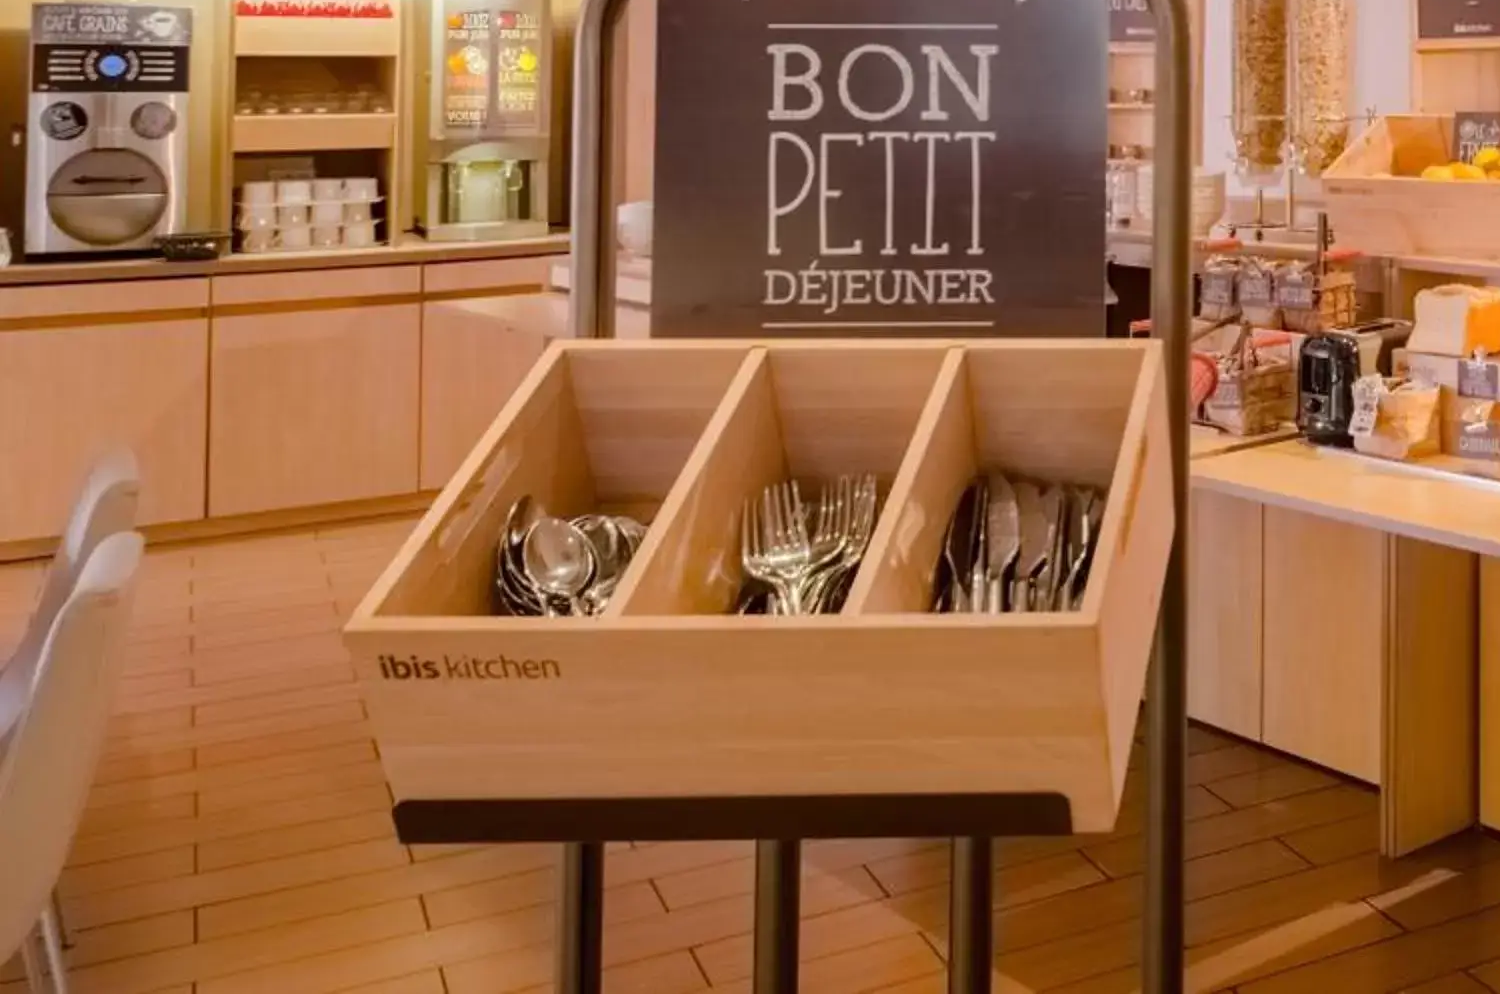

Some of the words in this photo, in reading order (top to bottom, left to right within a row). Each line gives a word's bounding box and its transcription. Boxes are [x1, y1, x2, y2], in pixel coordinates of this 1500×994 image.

[767, 44, 998, 122] BON
[766, 131, 997, 256] PETIT
[762, 261, 995, 313] DÉJEUNER
[378, 654, 440, 679] ibis
[444, 653, 561, 680] kitchen
